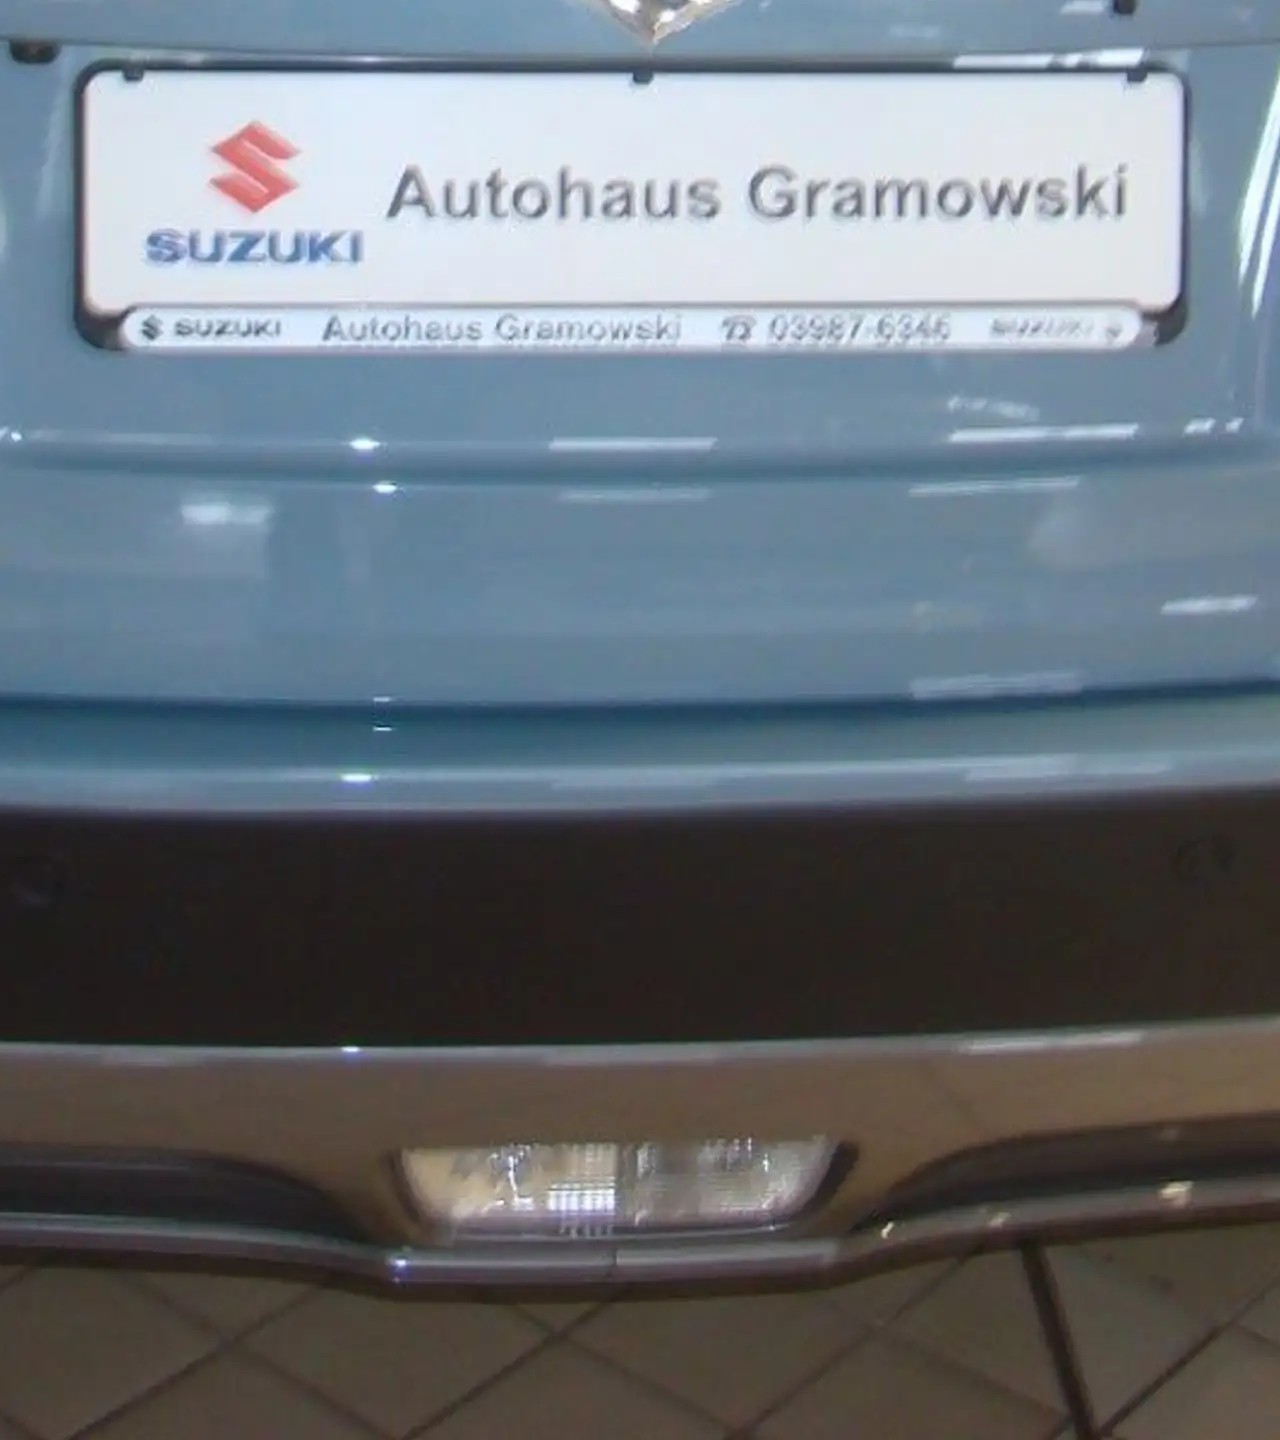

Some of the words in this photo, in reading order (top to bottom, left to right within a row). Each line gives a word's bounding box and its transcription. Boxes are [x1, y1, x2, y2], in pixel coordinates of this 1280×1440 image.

[386, 162, 721, 221] Autohaus
[748, 162, 1128, 221] Gramowski
[145, 227, 365, 264] SUZUKI
[174, 318, 282, 337] SUZUKI
[322, 315, 483, 342] Autohaus
[494, 314, 683, 342] Gramowski
